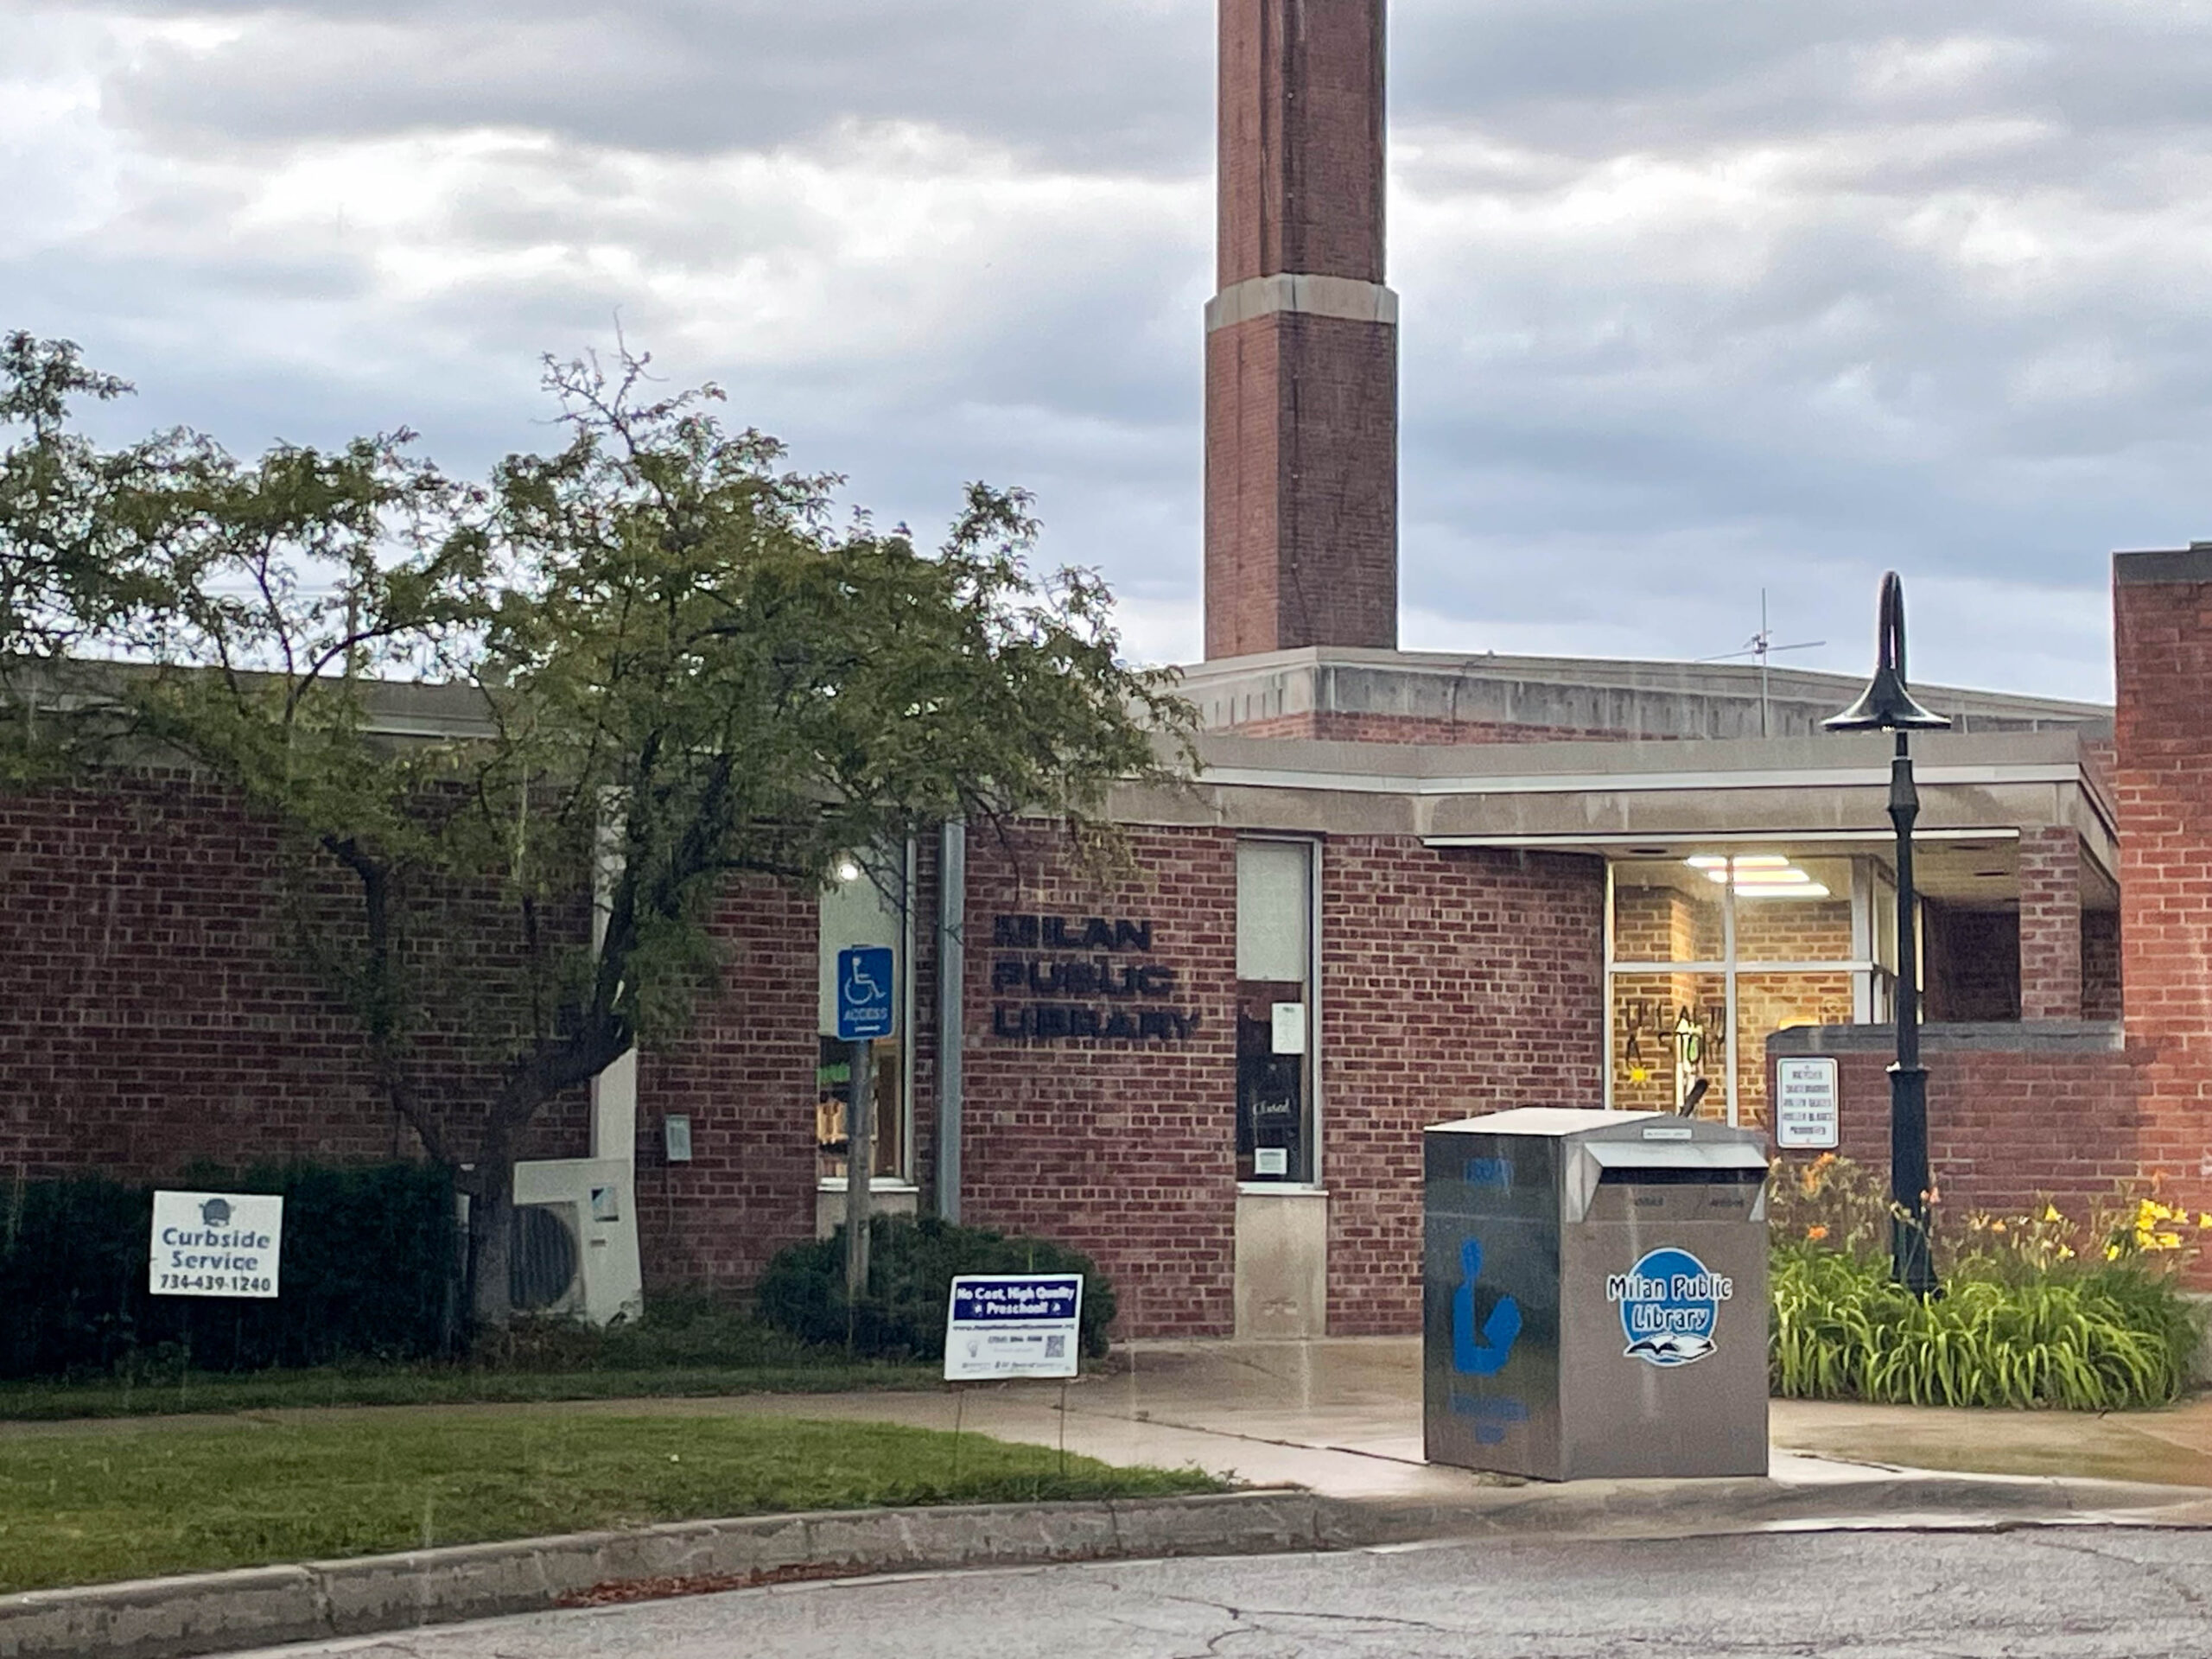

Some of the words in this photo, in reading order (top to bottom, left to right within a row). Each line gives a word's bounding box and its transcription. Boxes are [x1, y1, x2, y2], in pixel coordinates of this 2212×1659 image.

[994, 913, 1152, 951] MILAN
[992, 961, 1173, 994] PUBLIC
[994, 1005, 1202, 1039] LIBRARY
[162, 1227, 270, 1249] Curbside
[170, 1250, 258, 1271] Service
[956, 1287, 973, 1300] No
[1608, 1274, 1666, 1299] Milan
[1673, 1274, 1732, 1299] Public
[1633, 1305, 1708, 1330] Library
